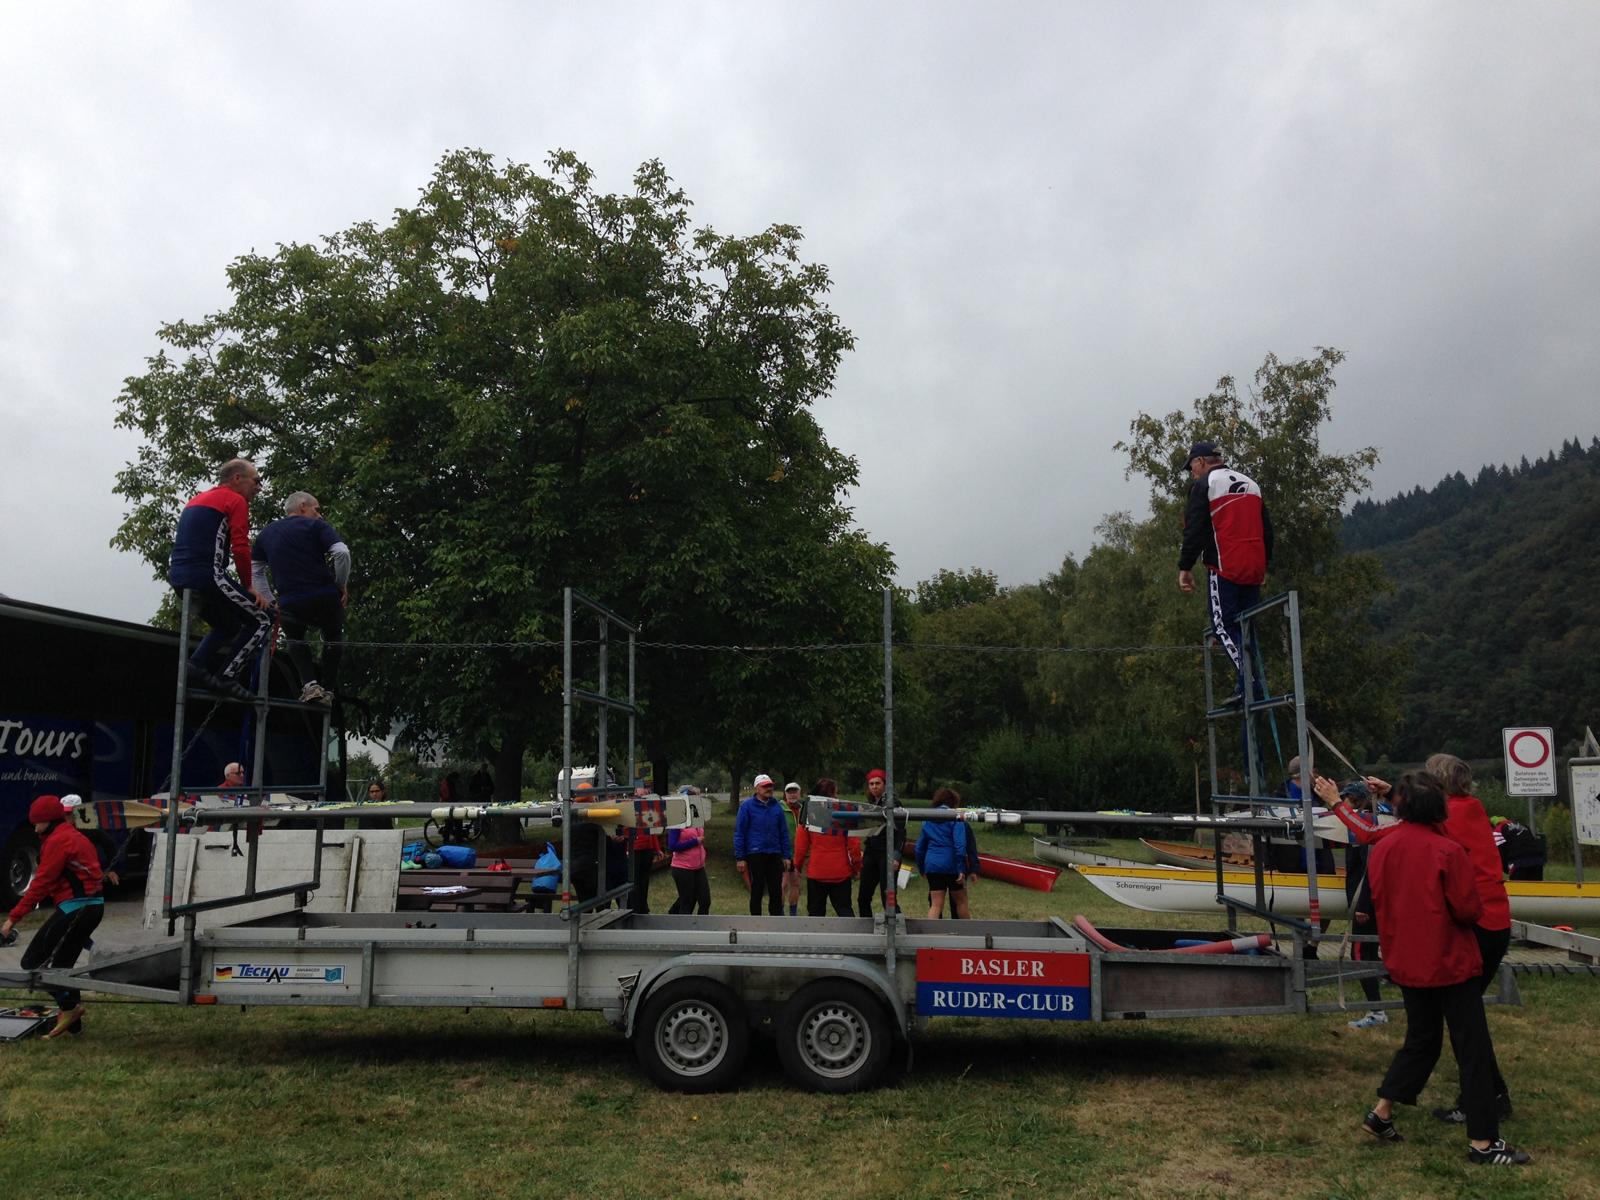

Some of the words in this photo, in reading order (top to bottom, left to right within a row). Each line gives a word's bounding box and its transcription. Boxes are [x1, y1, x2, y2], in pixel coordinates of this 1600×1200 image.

[0, 719, 87, 759] Tours
[238, 964, 289, 983] TECHAU
[961, 958, 1045, 977] BASLER
[933, 990, 1074, 1012] RUDER-CLUB
